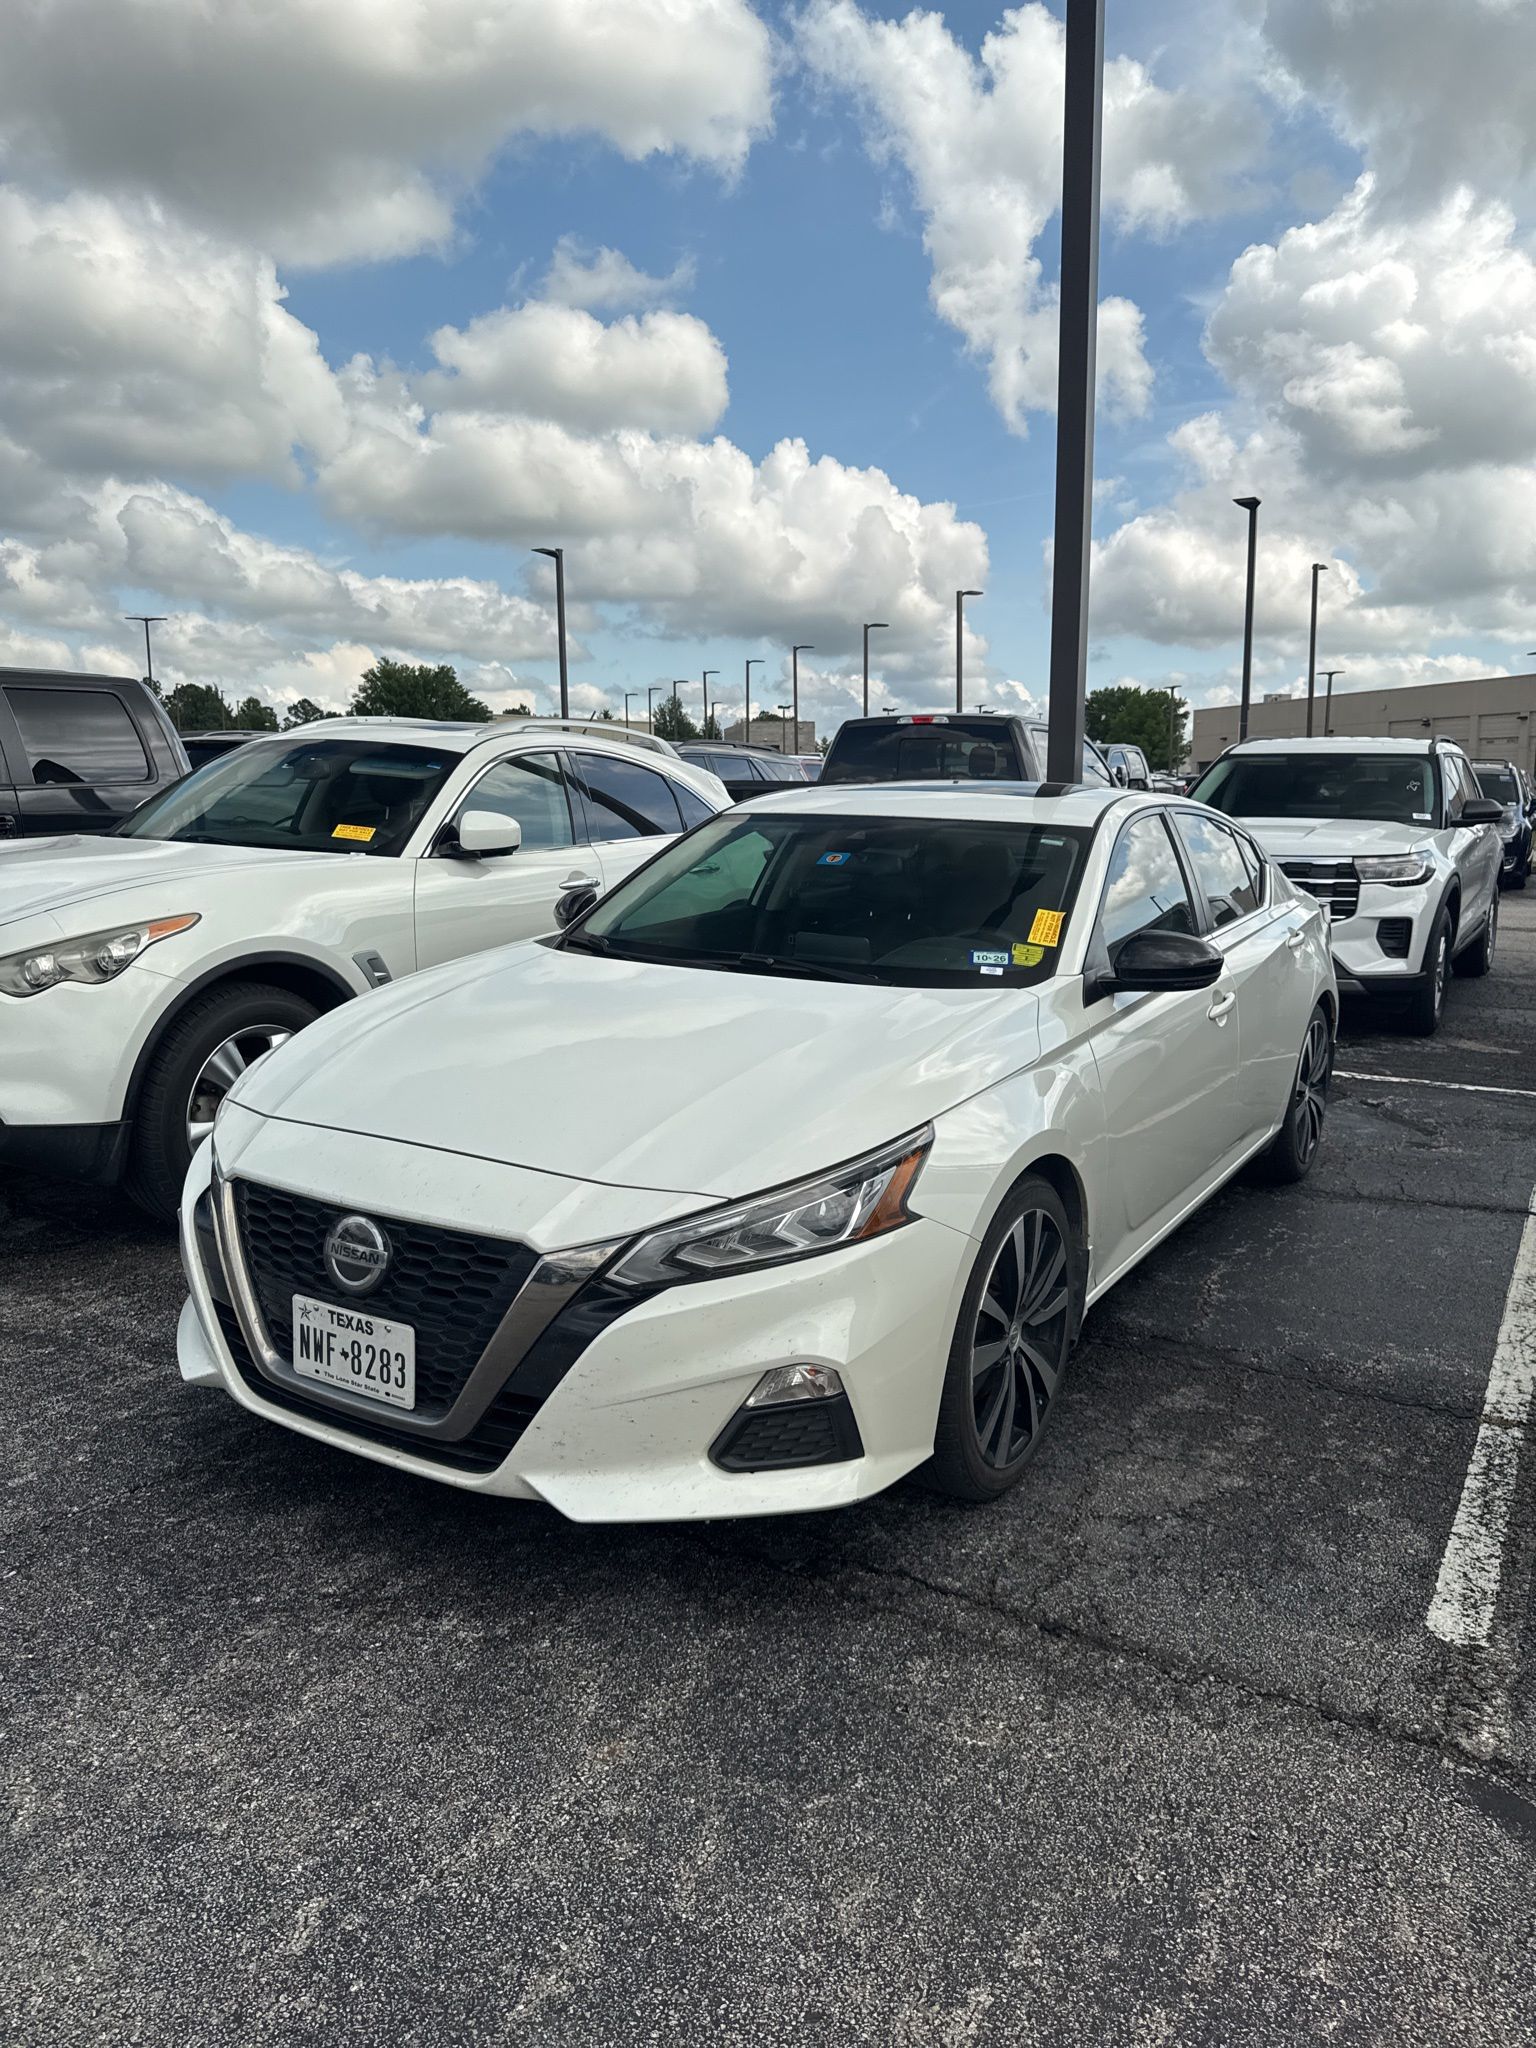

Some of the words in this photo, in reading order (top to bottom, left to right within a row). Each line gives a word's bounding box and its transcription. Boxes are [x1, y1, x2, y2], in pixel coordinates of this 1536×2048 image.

[331, 1242, 380, 1265] NISSAN
[327, 1310, 374, 1336] TEXAS
[323, 1371, 335, 1380] The
[336, 1375, 350, 1384] Lone
[350, 1380, 363, 1388] Star
[364, 1384, 380, 1394] State
